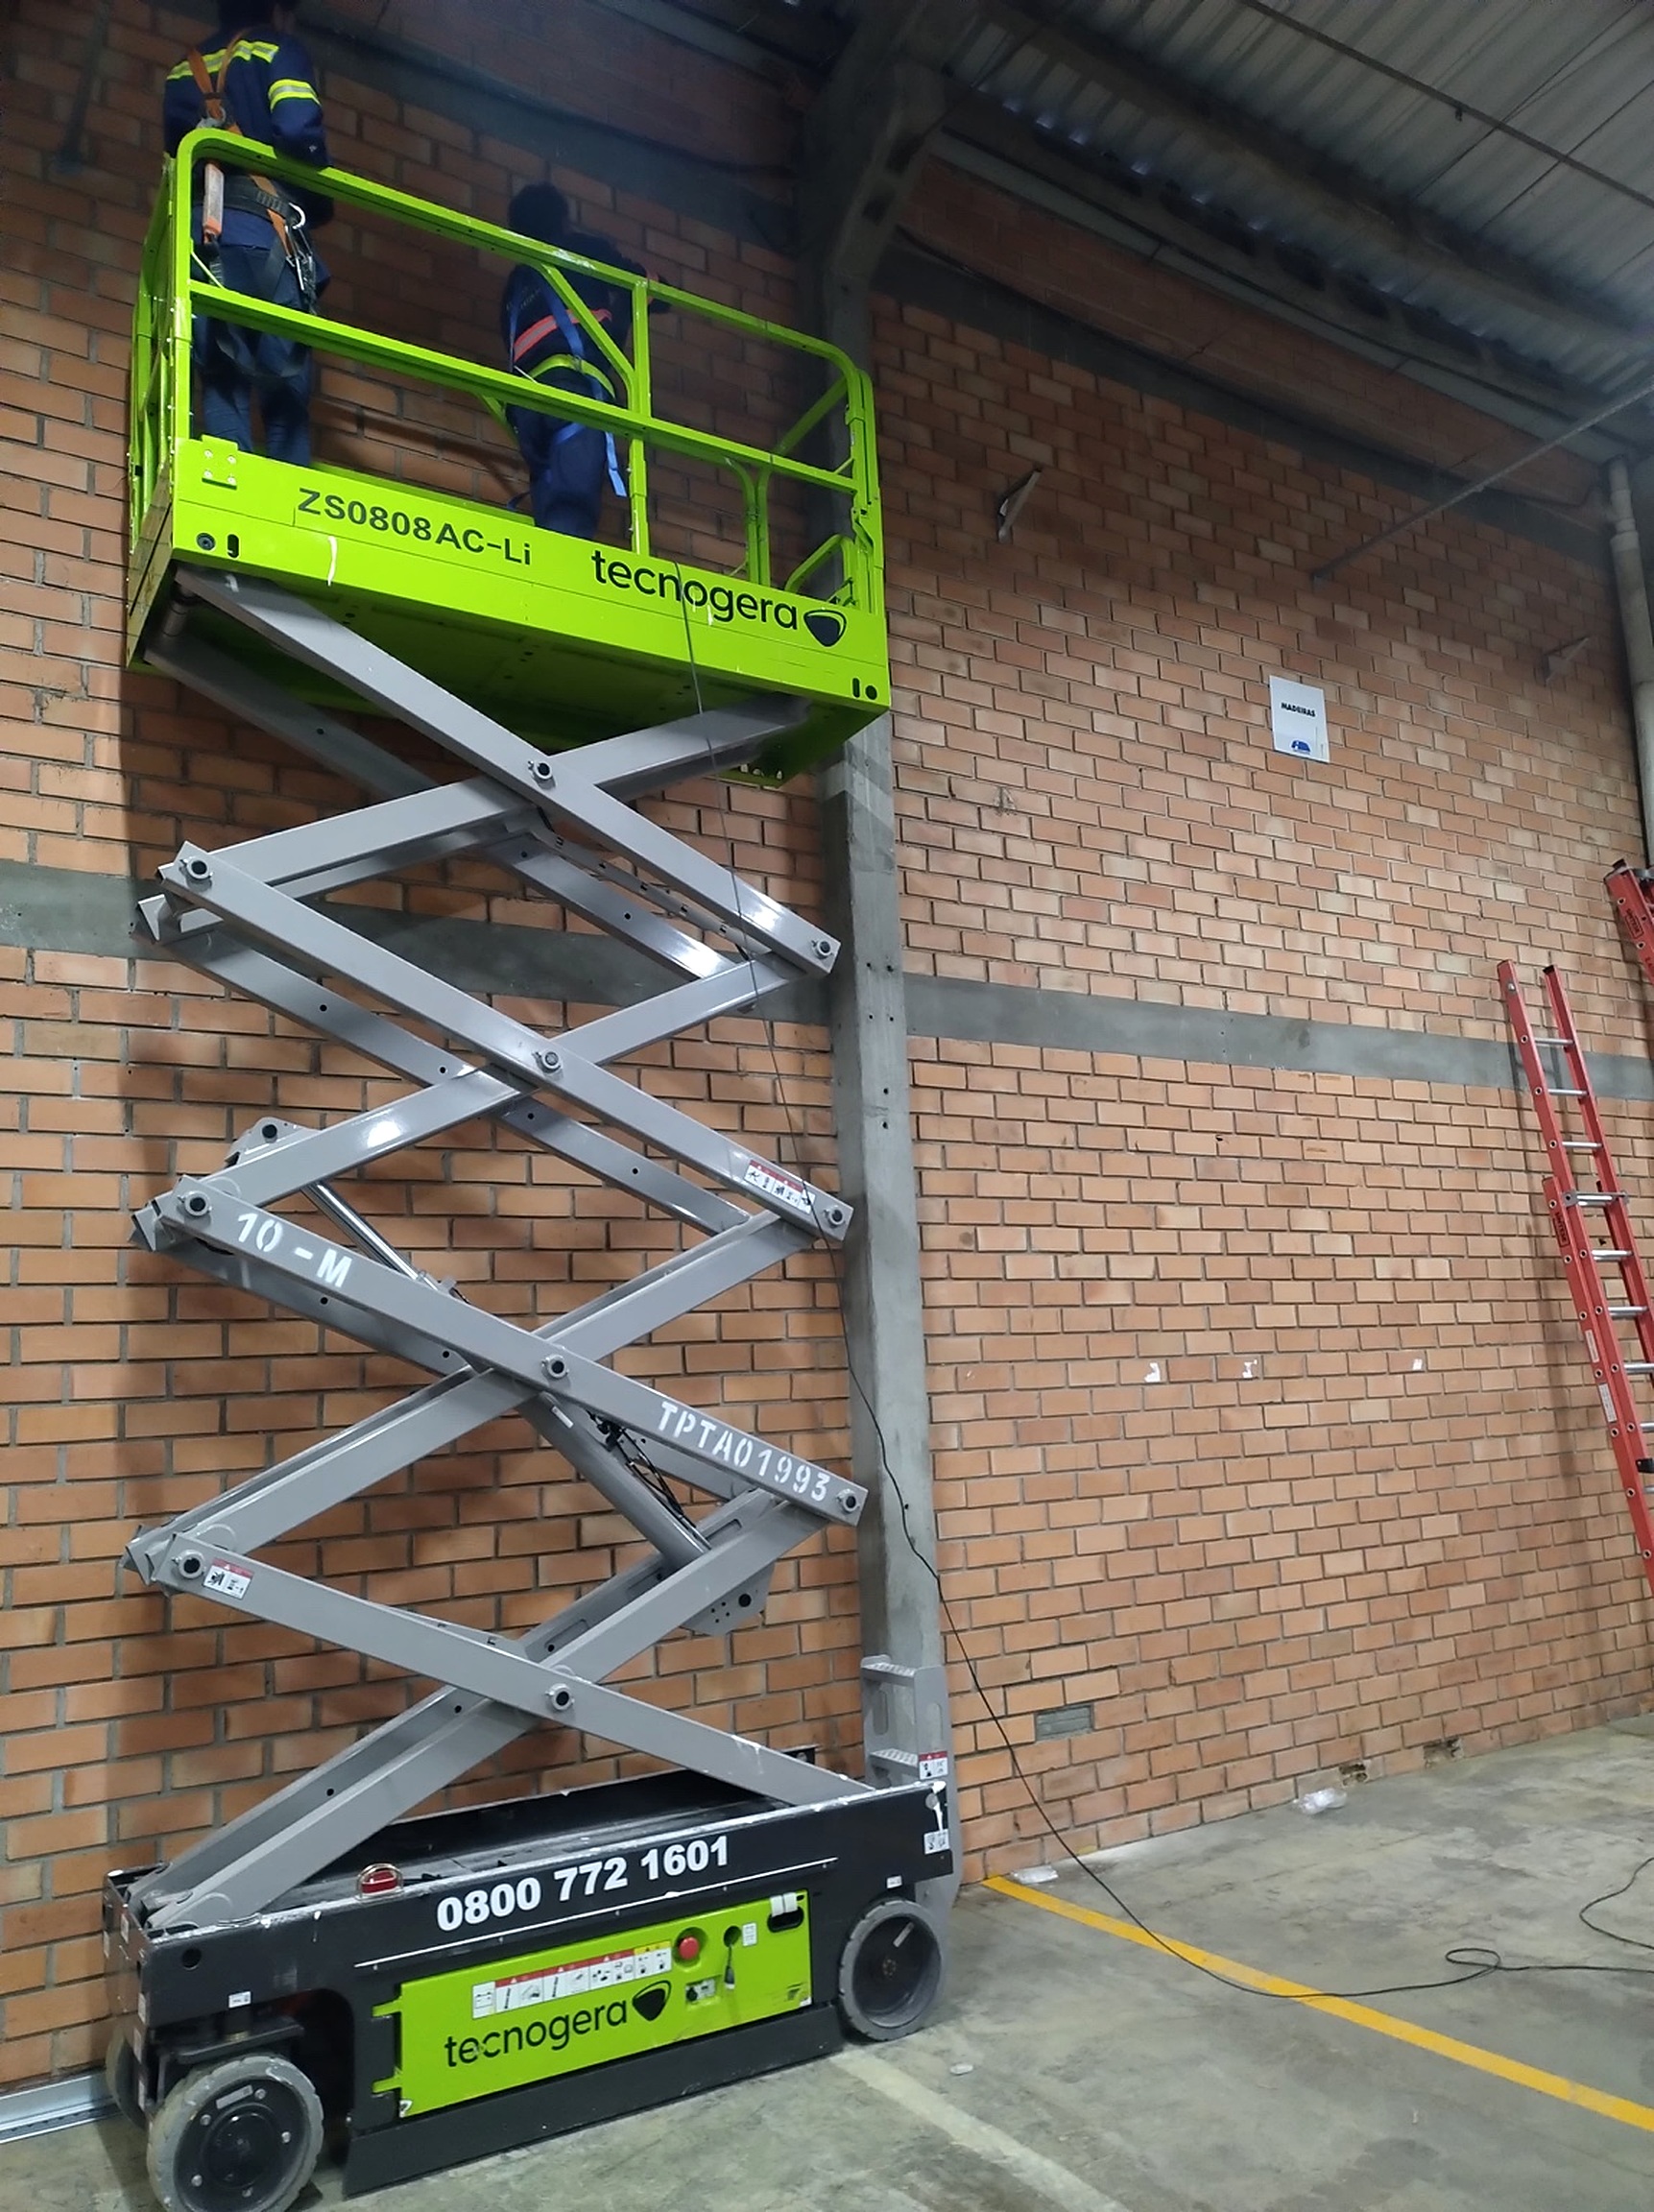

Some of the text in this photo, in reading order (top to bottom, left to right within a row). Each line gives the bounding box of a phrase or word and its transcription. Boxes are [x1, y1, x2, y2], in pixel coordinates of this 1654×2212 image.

[298, 487, 531, 565] ZS0808AC-Li
[591, 549, 798, 630] tecnogera
[1281, 702, 1316, 717] MADEIRAS
[658, 1401, 831, 1502] TPTA01993
[437, 1836, 728, 1932] 0800 772 1601
[443, 2000, 627, 2068] tecnogera
